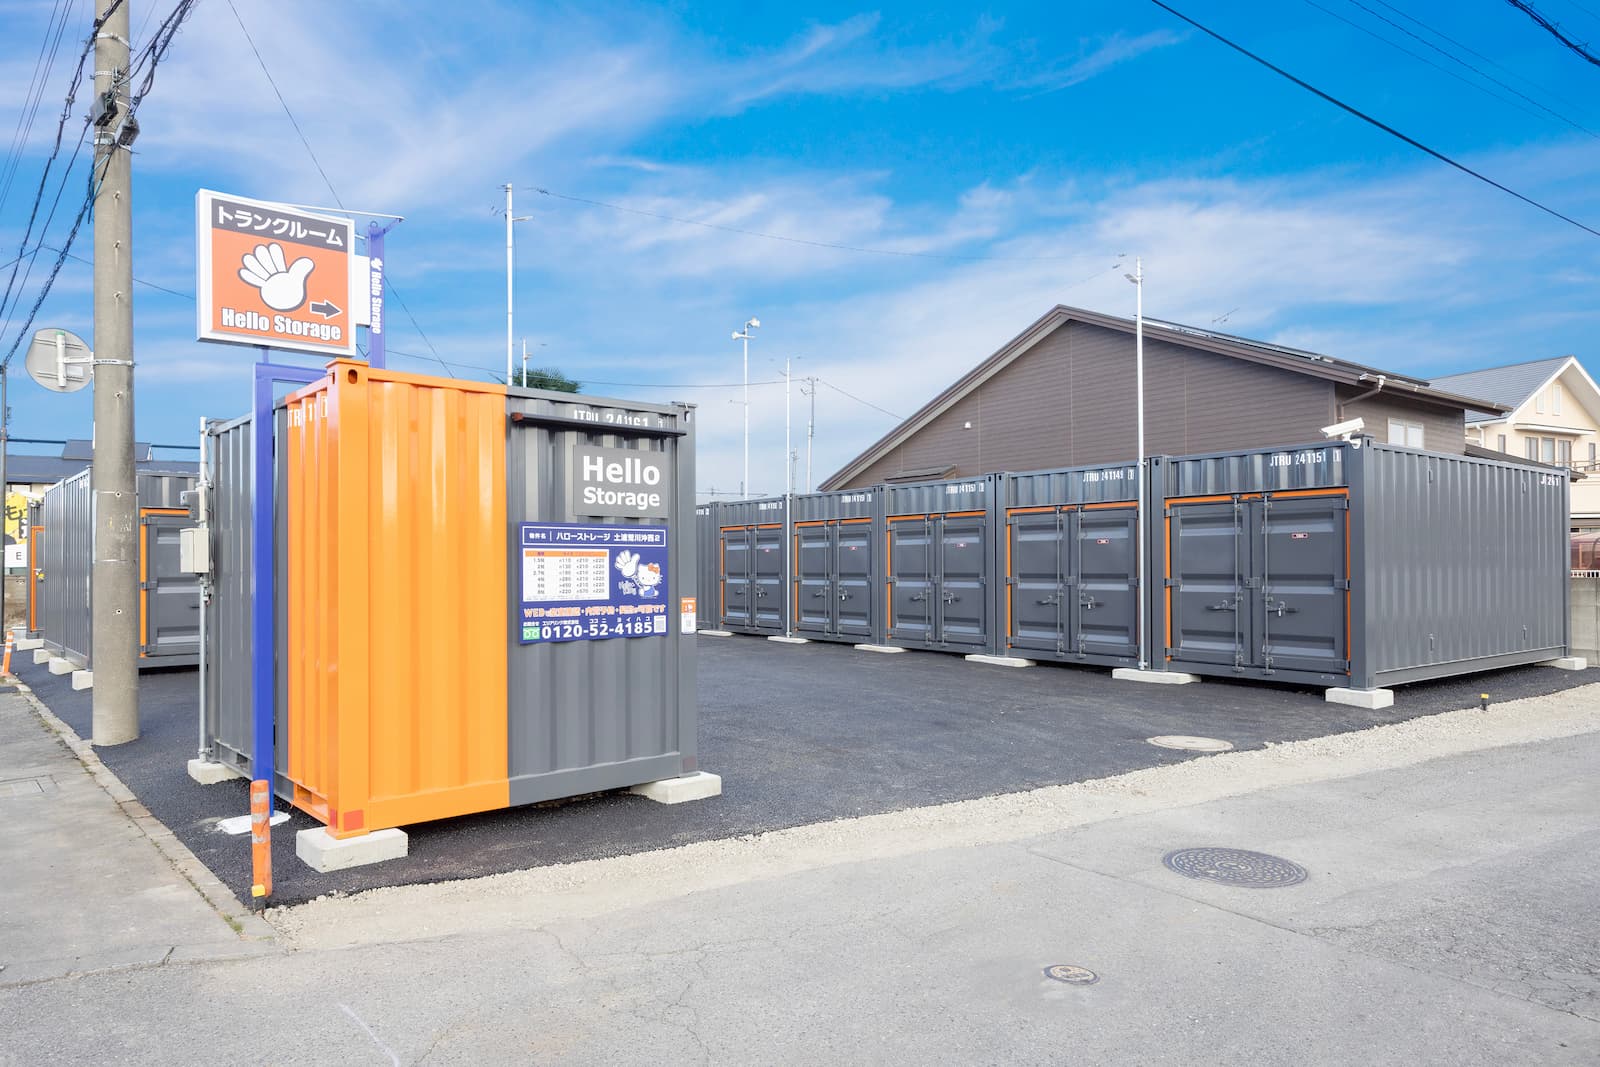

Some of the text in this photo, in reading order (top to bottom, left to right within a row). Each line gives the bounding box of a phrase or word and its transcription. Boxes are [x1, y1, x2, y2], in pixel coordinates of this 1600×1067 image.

[218, 206, 343, 247] トランクルーム
[371, 271, 382, 335] Hello Storage
[221, 307, 342, 341] Hello Storage
[583, 455, 661, 486] Hello
[1270, 455, 1292, 467] JTRU
[1295, 451, 1326, 465] 241151
[583, 486, 661, 510] Storage
[556, 532, 611, 541] ハローストレージ
[541, 621, 653, 639] 0120-52-4185
